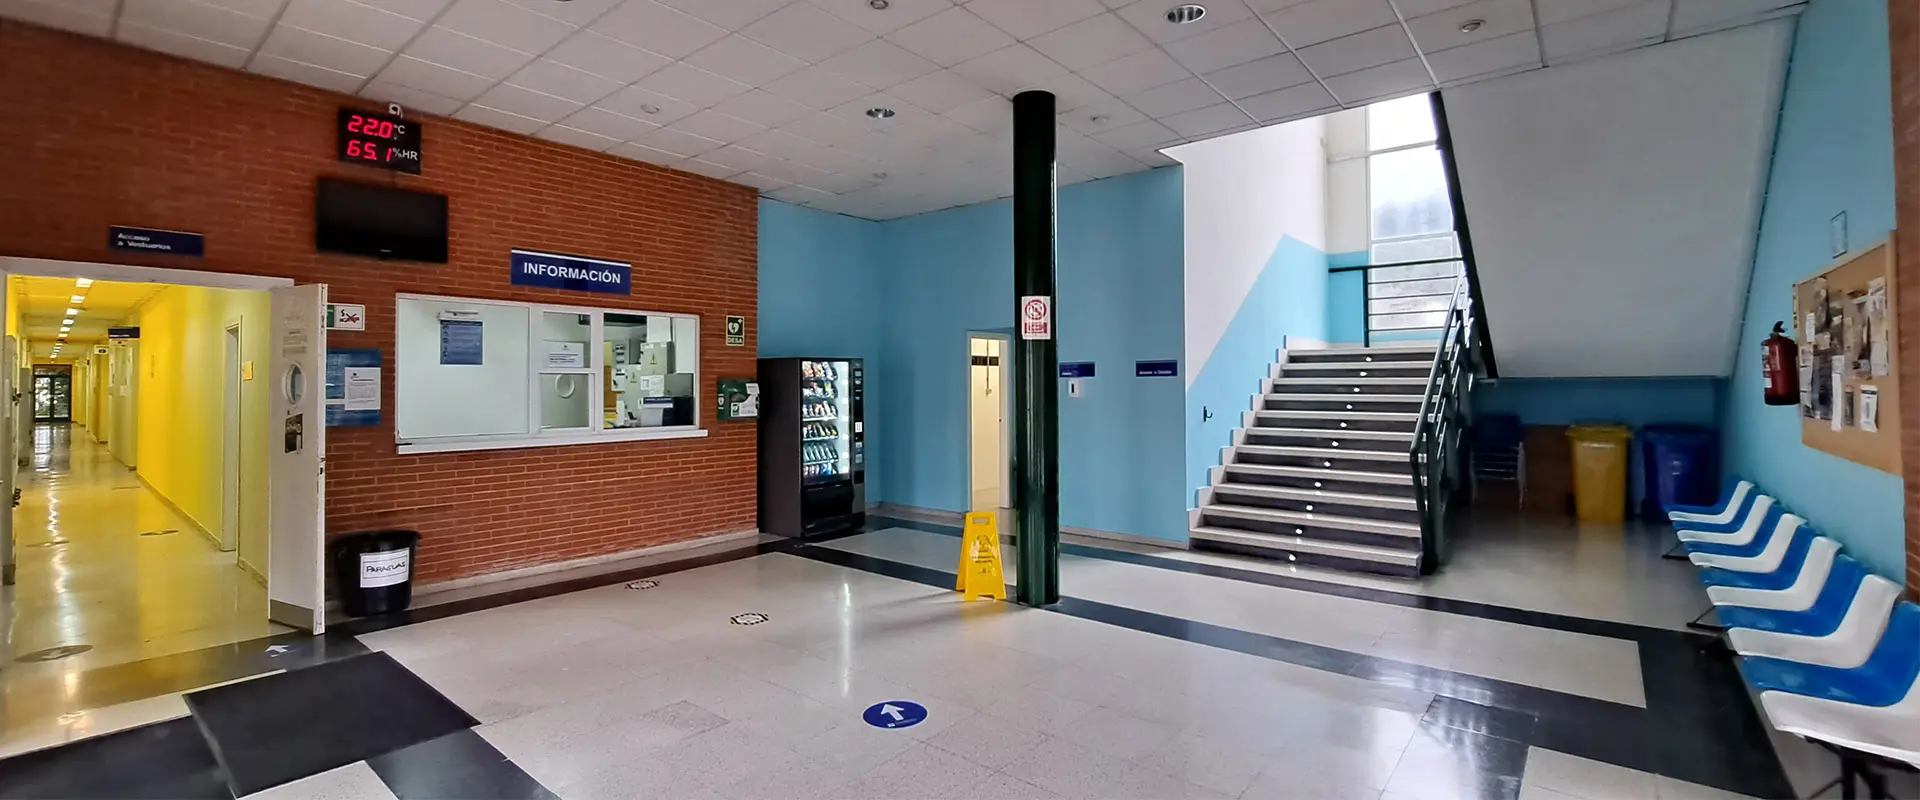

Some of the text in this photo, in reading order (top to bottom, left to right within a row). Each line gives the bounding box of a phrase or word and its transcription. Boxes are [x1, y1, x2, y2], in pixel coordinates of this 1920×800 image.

[347, 115, 393, 139] 22.0
[346, 139, 393, 162] 65.1
[523, 262, 621, 284] INFORMACIÓN
[366, 561, 406, 573] PARAGUAS
